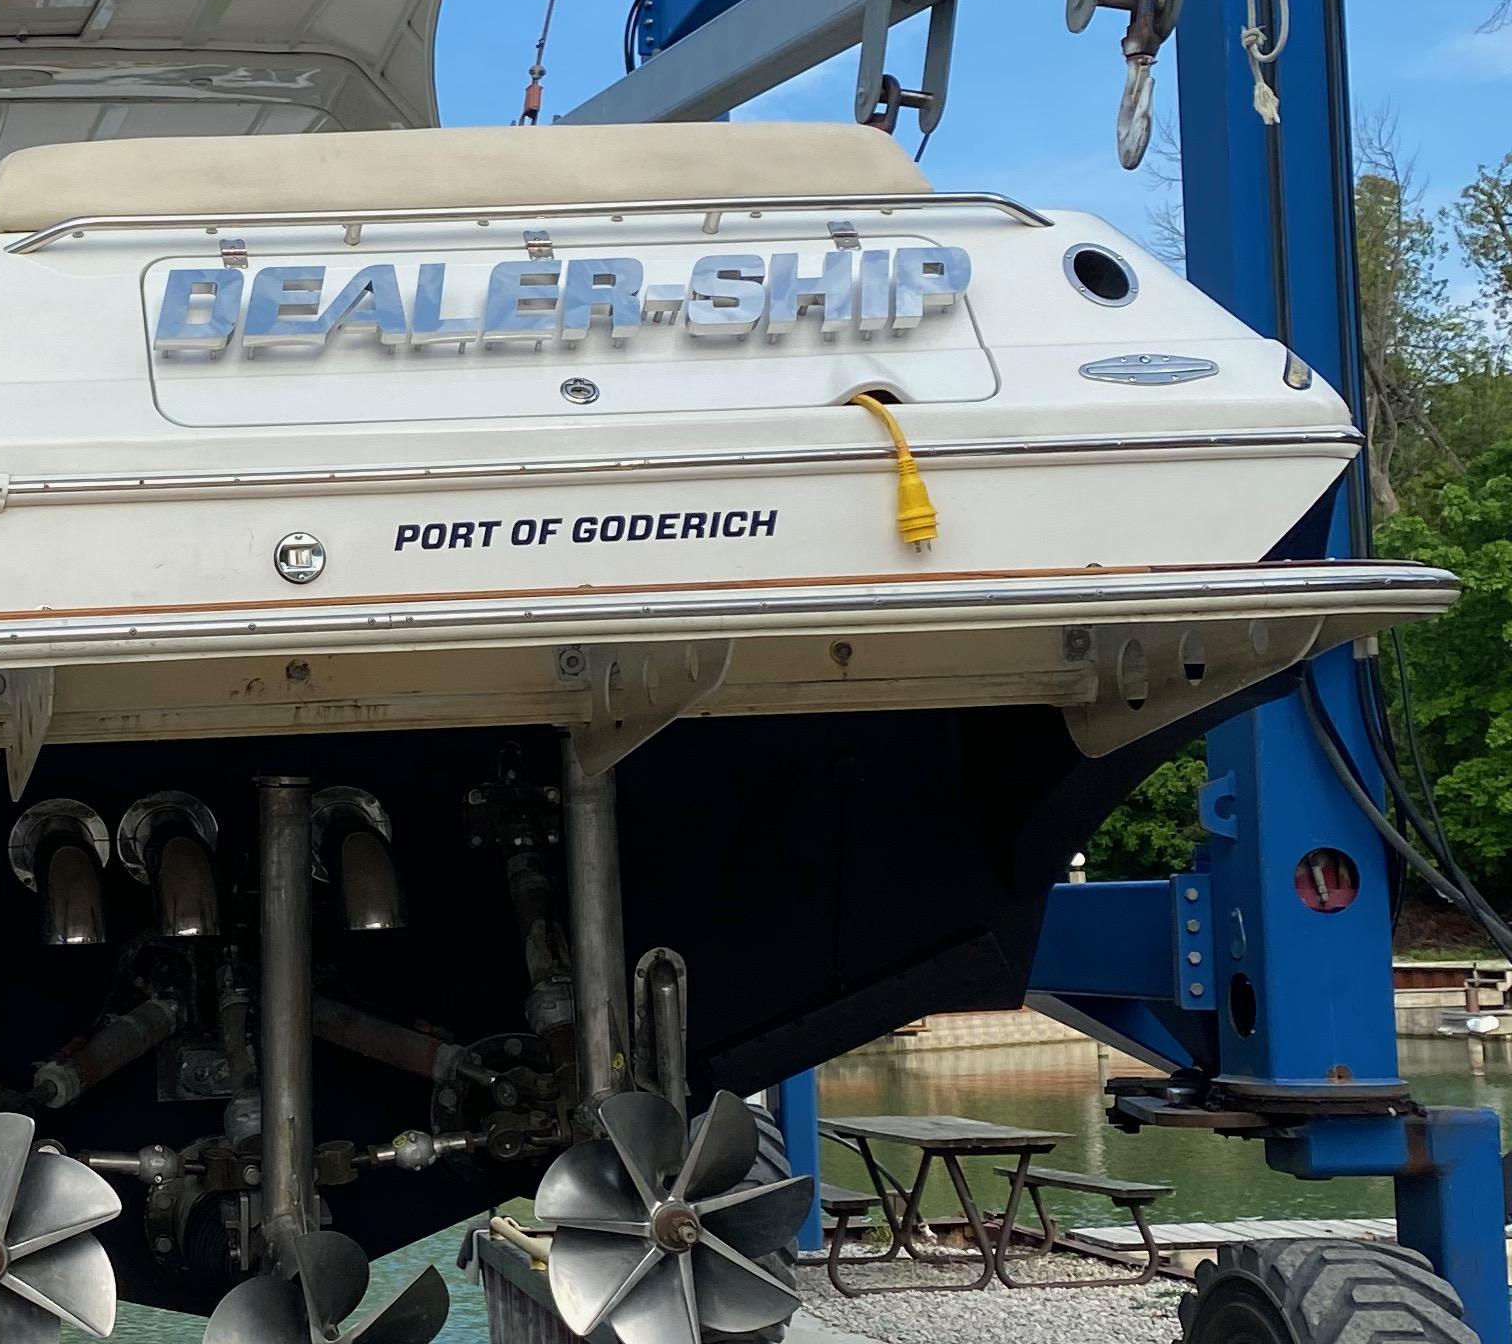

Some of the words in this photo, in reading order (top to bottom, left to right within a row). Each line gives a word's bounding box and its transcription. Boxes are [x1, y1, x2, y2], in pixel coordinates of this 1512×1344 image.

[154, 247, 971, 353] DEALER-SHIP
[393, 520, 502, 552] PORT
[510, 517, 563, 546] OF
[571, 509, 778, 543] GODERICH
